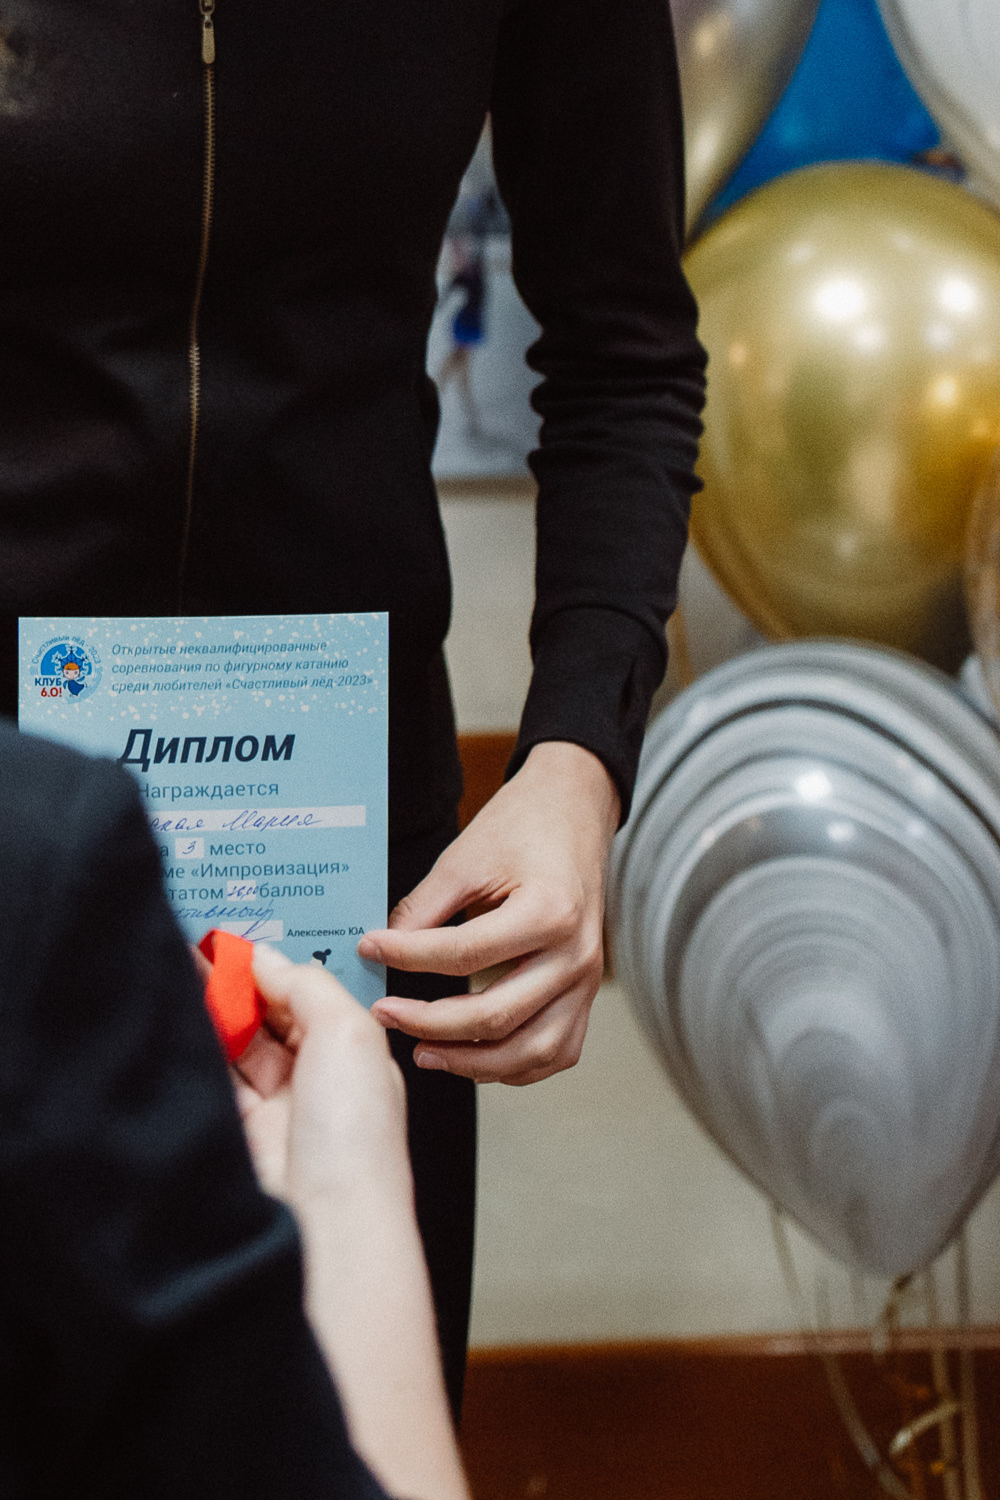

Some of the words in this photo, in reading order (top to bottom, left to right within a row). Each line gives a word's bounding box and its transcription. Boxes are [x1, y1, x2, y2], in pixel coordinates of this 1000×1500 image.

[112, 643, 177, 656] Открытые
[180, 641, 327, 655] неквалифицированные
[111, 663, 202, 675] соревнования
[205, 663, 220, 672] по
[224, 660, 292, 673] фигурному
[295, 659, 349, 670] катанию
[34, 677, 62, 686] КЛУБ
[112, 681, 149, 693] среди
[152, 679, 222, 692] любителей
[225, 676, 308, 690] «Счастливый
[117, 728, 296, 773] Диплом
[209, 842, 266, 856] место
[190, 861, 350, 880] «Импровизация»
[259, 883, 325, 898] баллов
[286, 928, 346, 938] Алексеенко
